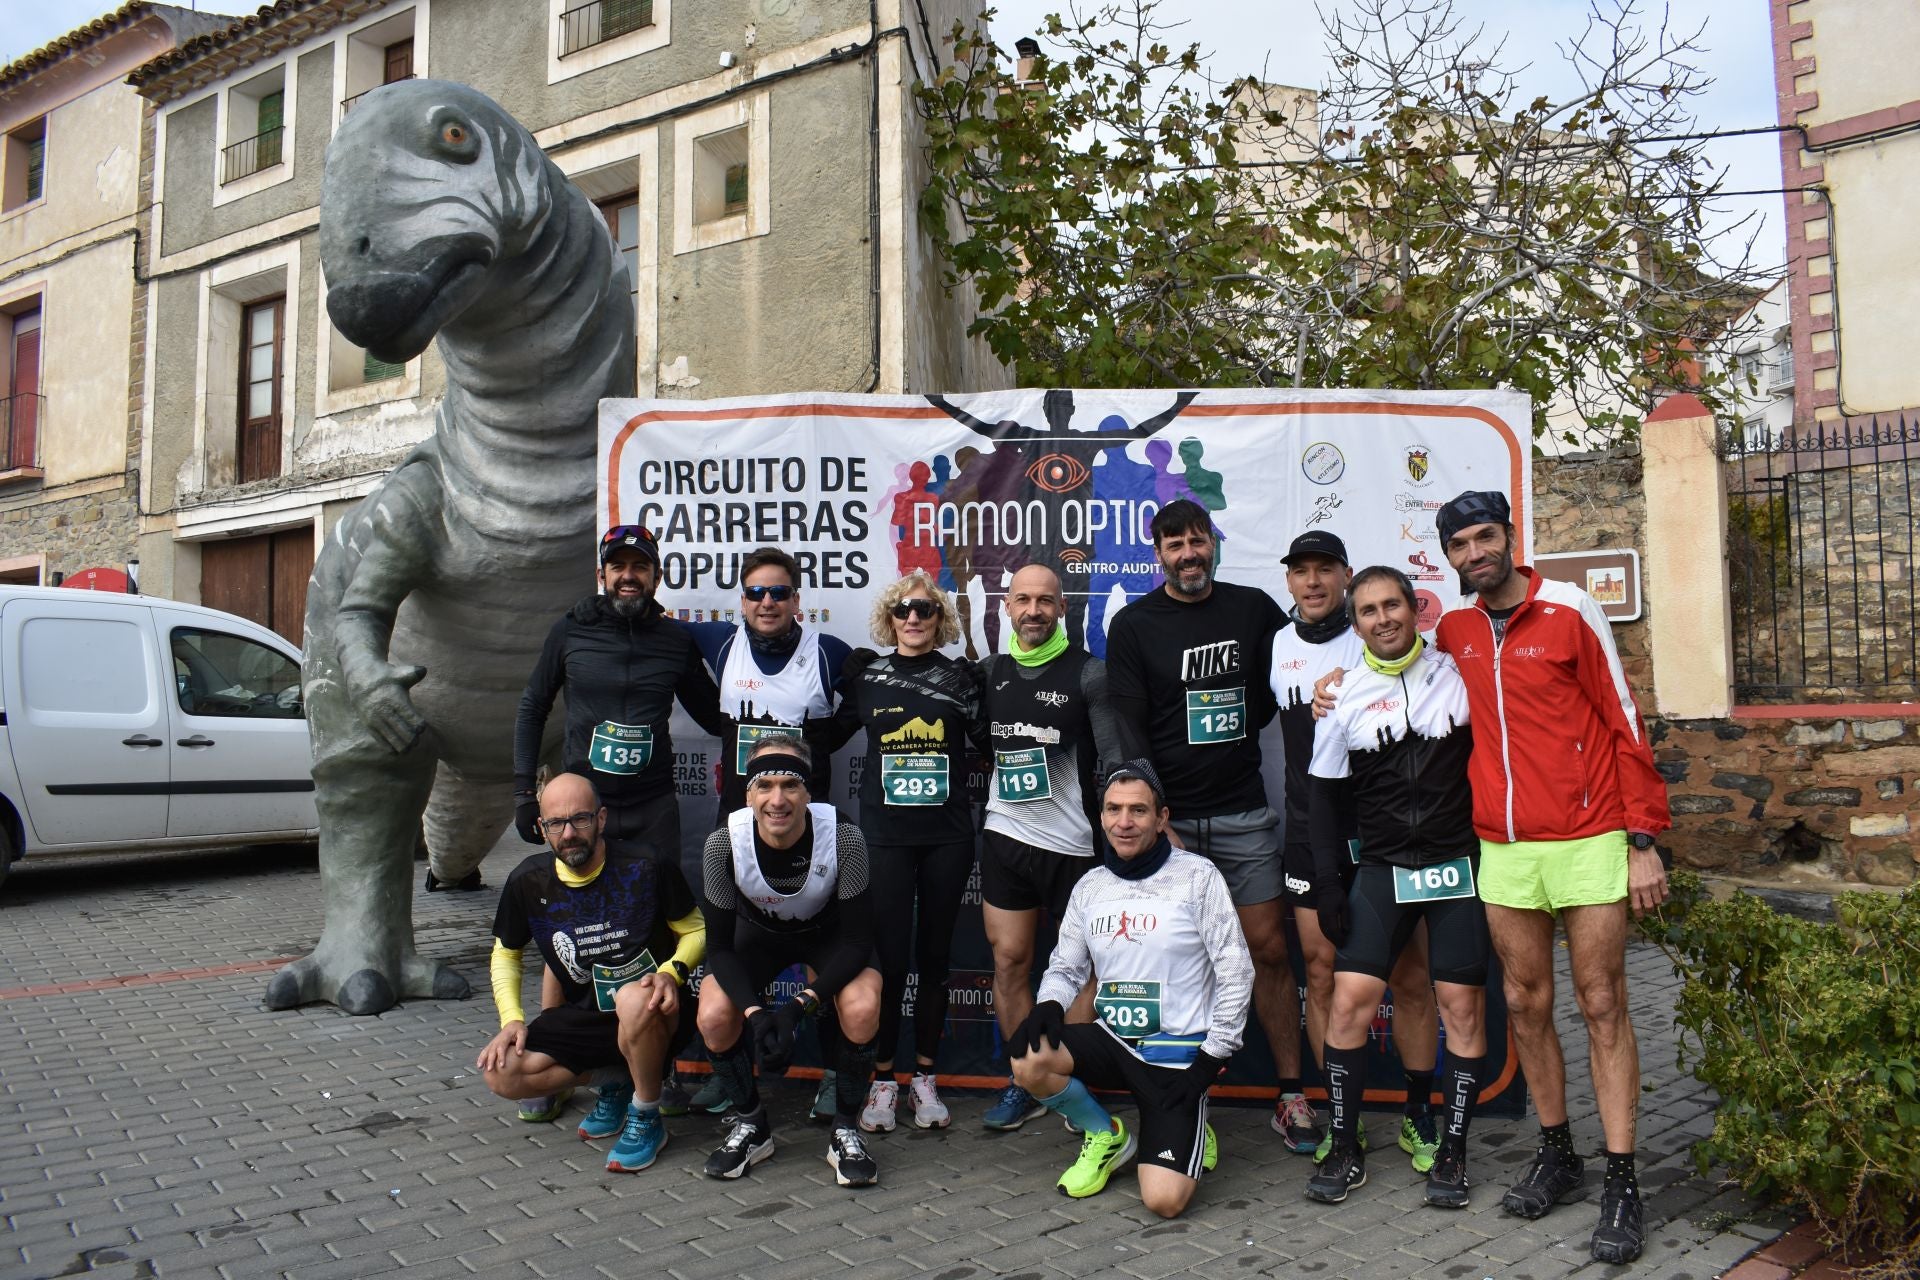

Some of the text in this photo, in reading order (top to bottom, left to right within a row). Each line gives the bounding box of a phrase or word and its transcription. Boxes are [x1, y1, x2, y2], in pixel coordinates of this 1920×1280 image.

[1307, 446, 1327, 465] RINCON
[639, 457, 868, 495] CIRCUITO DE
[1317, 459, 1340, 481] ATLETISMO
[638, 500, 869, 543] CARRERAS
[914, 499, 1180, 547] RAMON OPTIC
[663, 551, 870, 590] OPURES
[1066, 562, 1164, 575] CENTRO AUDIT
[1181, 640, 1240, 682] NIKE
[1200, 712, 1239, 733] 125
[601, 745, 642, 766] 135
[893, 778, 938, 796] 293
[1002, 772, 1038, 792] 119
[1408, 866, 1460, 890] 160
[576, 929, 629, 946] CARRERAS POPULARES
[1103, 1005, 1149, 1028] 203
